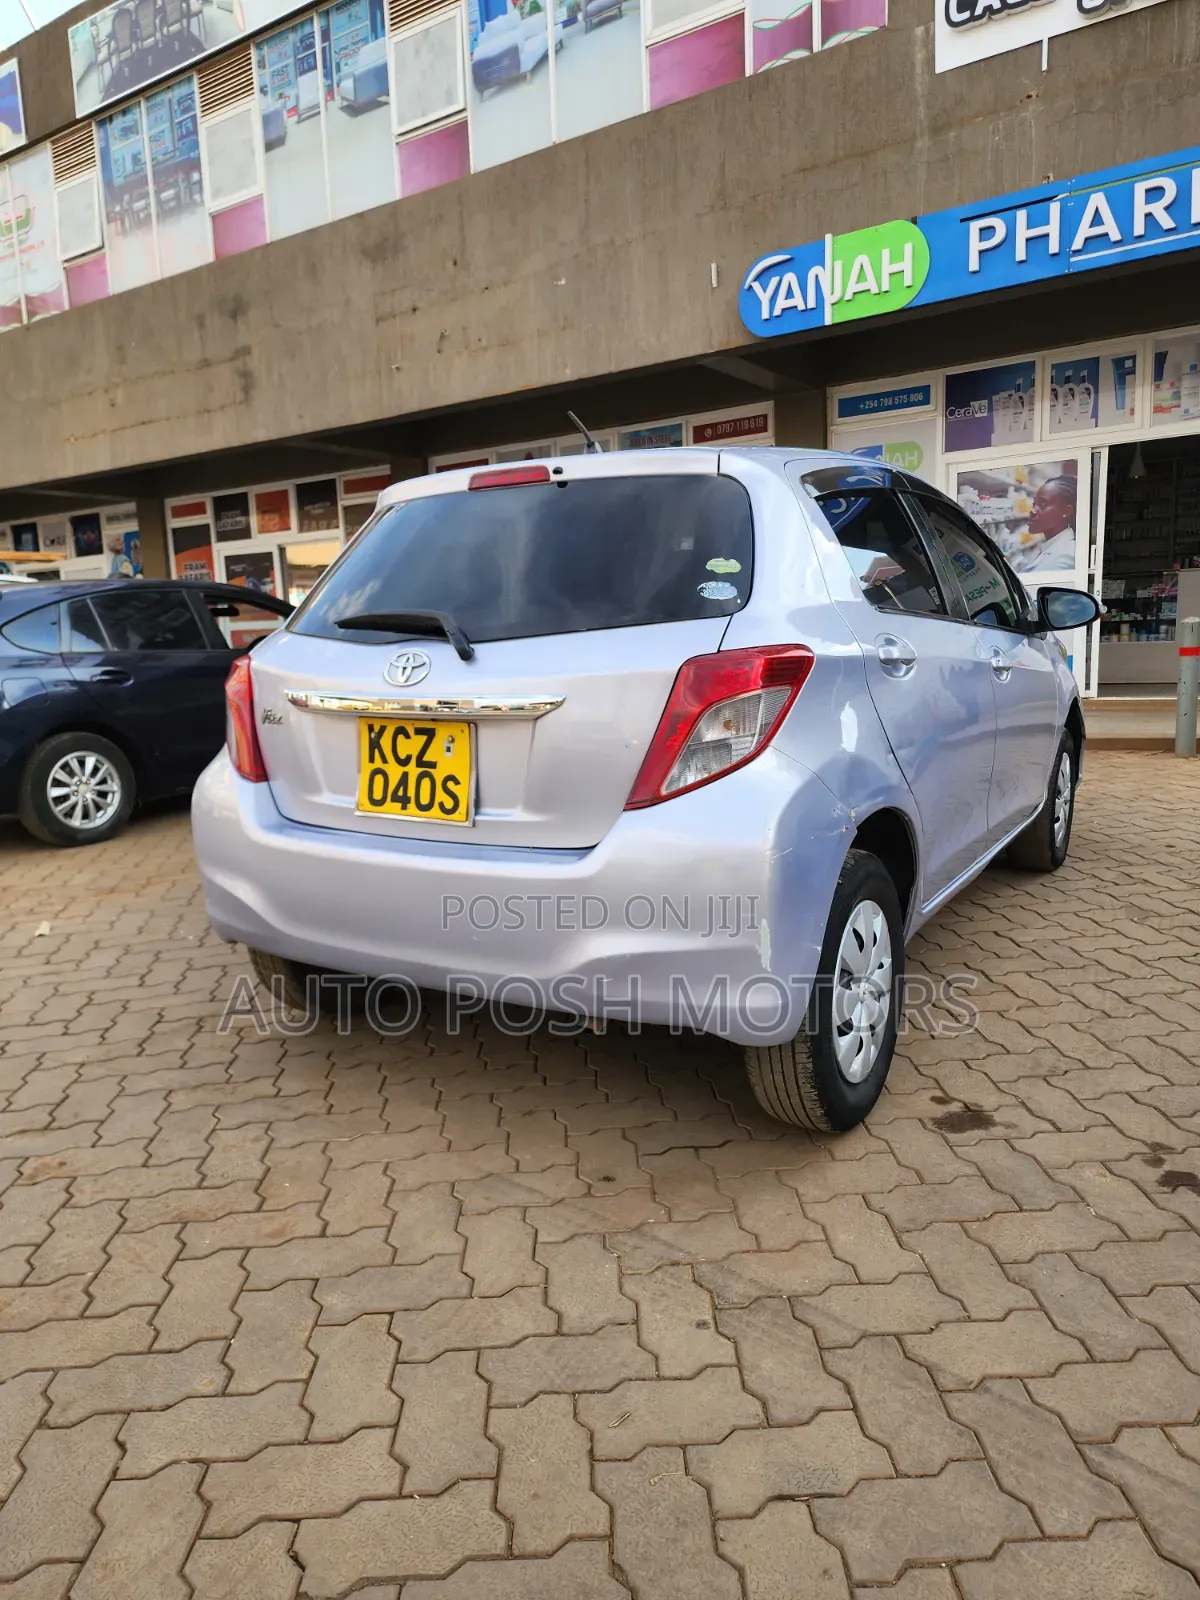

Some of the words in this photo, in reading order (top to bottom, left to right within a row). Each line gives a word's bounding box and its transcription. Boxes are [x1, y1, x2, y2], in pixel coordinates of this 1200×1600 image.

[968, 168, 1200, 273] PHAR
[745, 236, 914, 322] YANJAH
[859, 399, 878, 410] +254
[880, 398, 893, 408] 798
[895, 395, 908, 405] 575
[910, 392, 924, 402] 806
[946, 399, 988, 420] CeraVe
[717, 422, 734, 434] 0797
[737, 419, 749, 431] 119
[367, 723, 437, 769] KCZ
[367, 767, 461, 815] 040S
